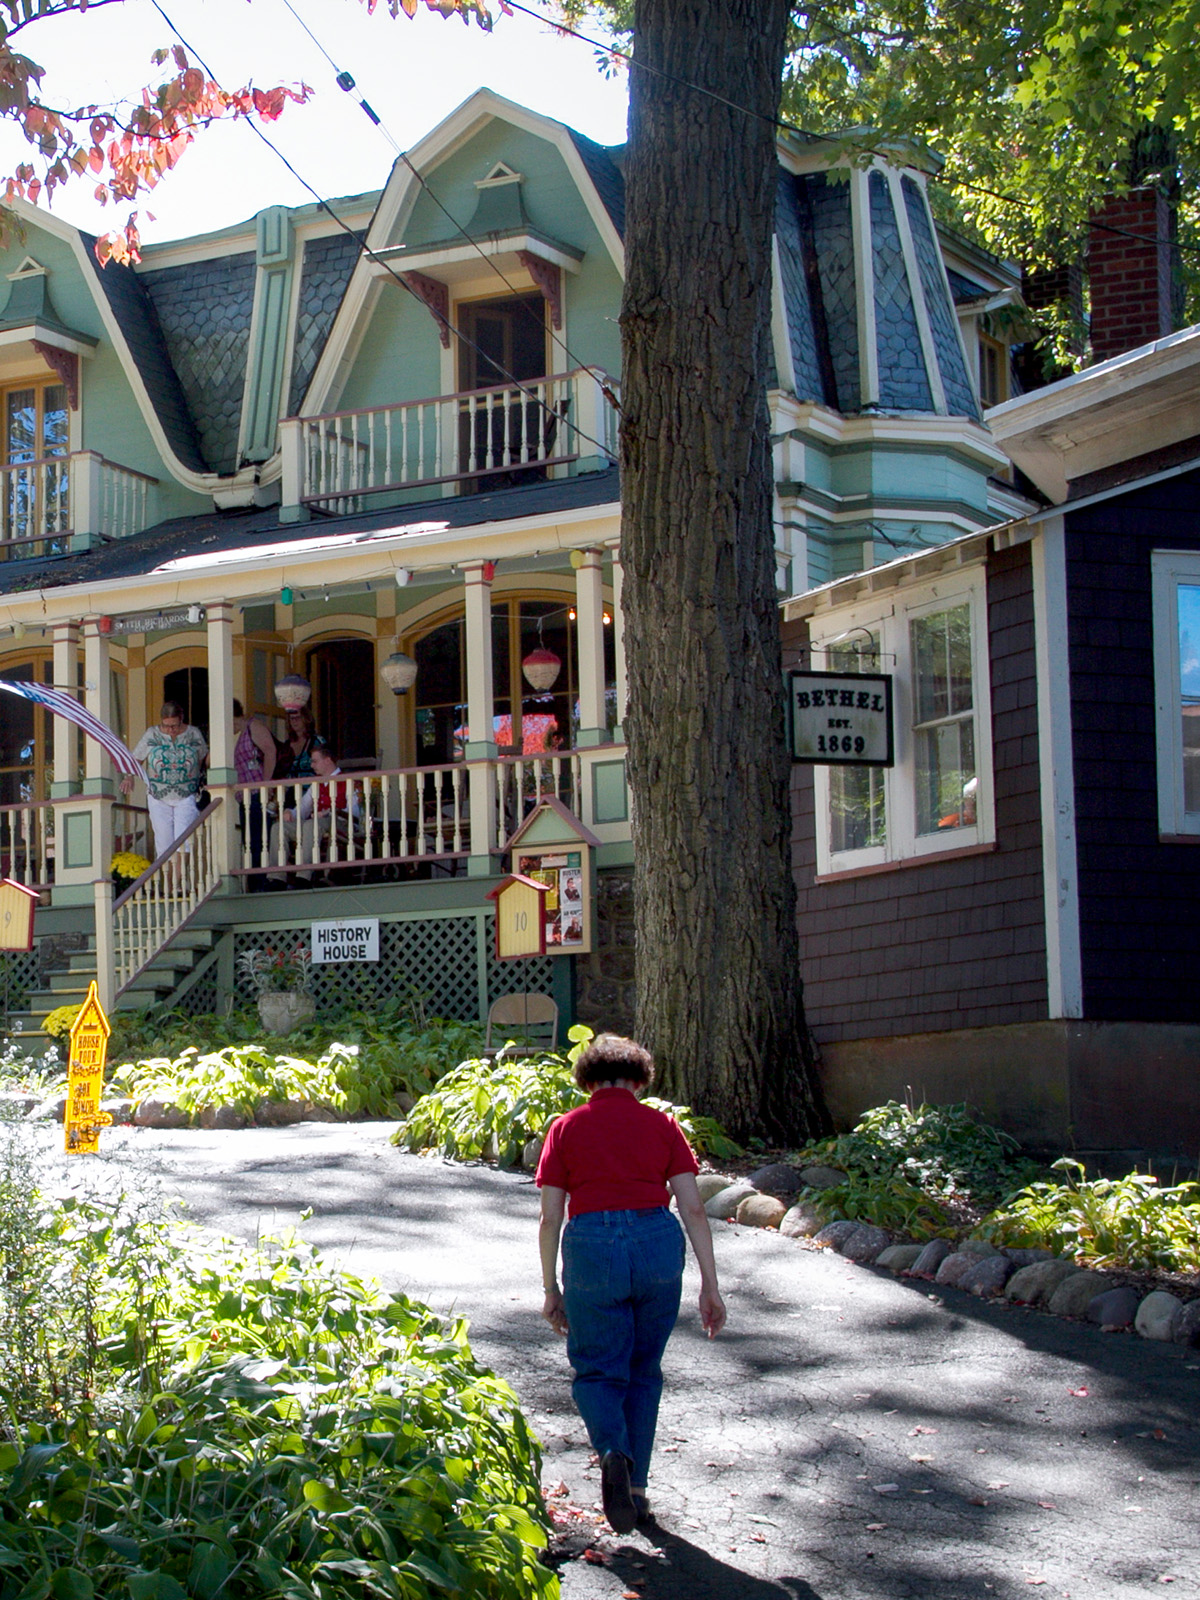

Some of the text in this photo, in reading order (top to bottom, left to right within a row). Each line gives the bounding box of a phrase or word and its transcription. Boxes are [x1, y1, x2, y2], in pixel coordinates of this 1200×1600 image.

[796, 688, 885, 712] BETHEL
[827, 718, 853, 729] EST.
[818, 735, 865, 753] 1869
[4, 911, 12, 929] 9
[514, 911, 528, 933] 10
[318, 926, 371, 943] HISTORY
[323, 944, 367, 960] HOUSE
[78, 1035, 100, 1049] HOUSE
[79, 1050, 97, 1063] TOUR
